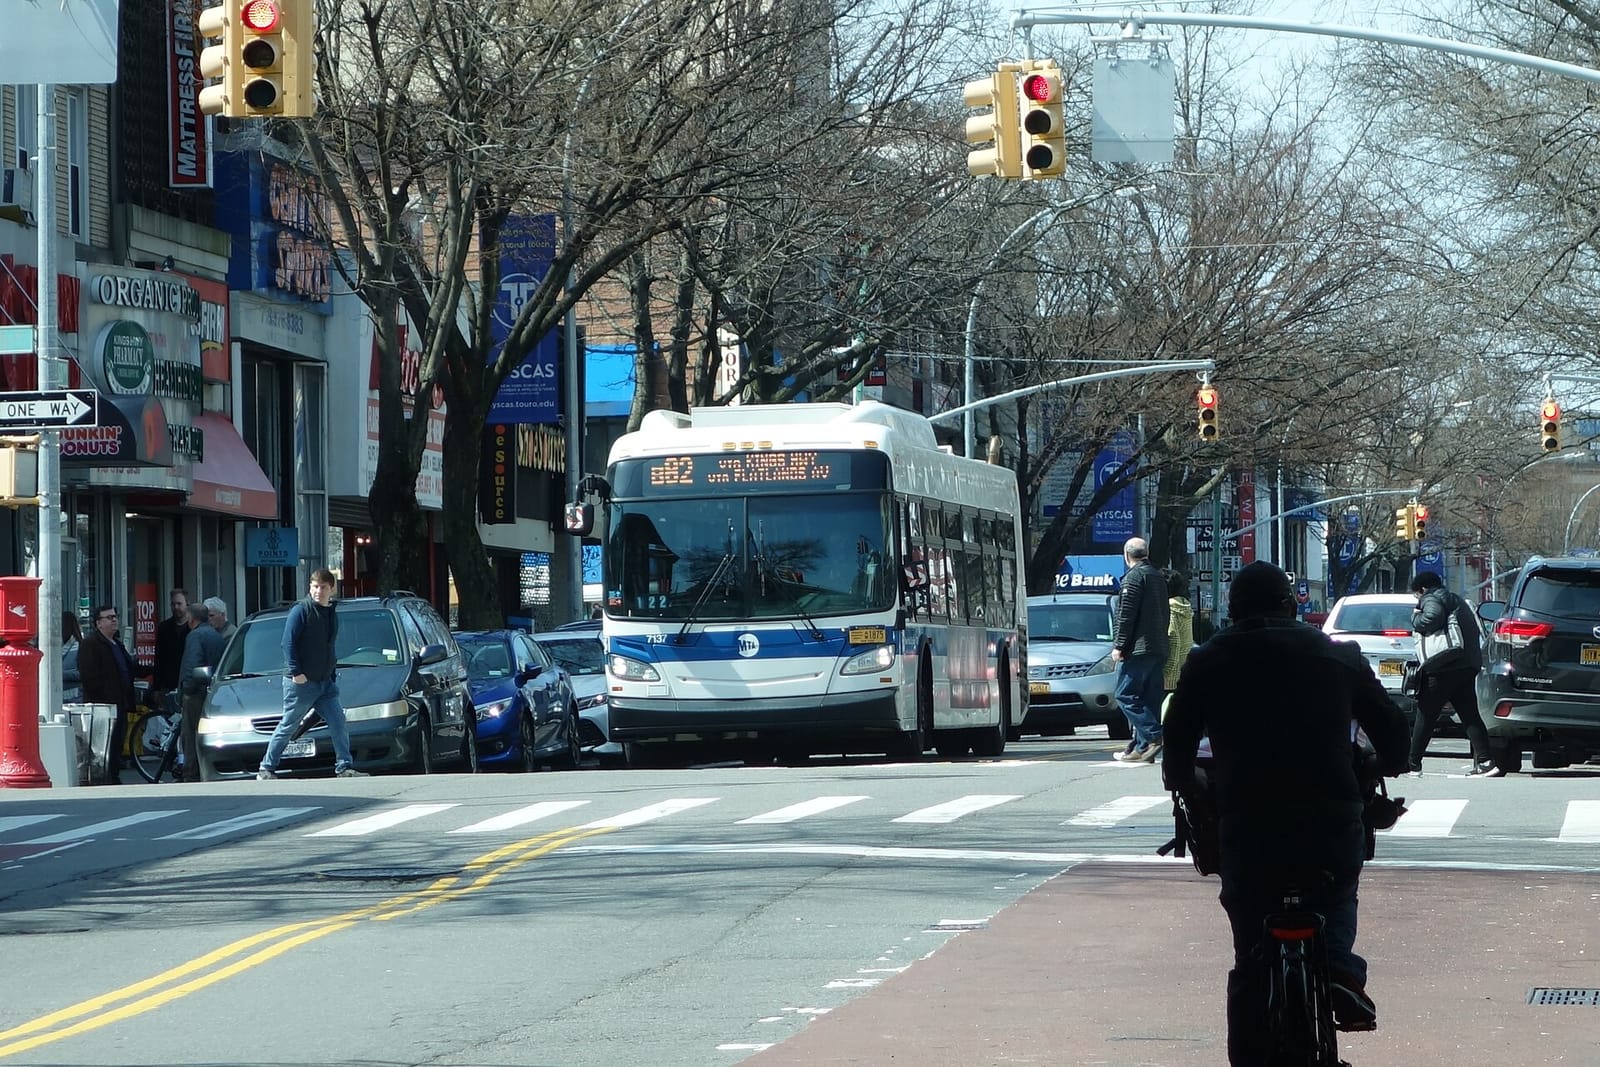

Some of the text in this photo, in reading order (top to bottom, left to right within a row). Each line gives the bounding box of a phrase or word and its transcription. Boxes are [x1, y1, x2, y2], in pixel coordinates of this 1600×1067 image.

[100, 275, 179, 313] ORGANIC
[113, 346, 144, 366] PHARMACY
[510, 363, 555, 379] SCAS
[7, 402, 80, 417] ONE WAY
[492, 399, 555, 409] yscas.touro.edu
[1071, 573, 1114, 587] Bank
[136, 601, 154, 619] TOP
[136, 621, 154, 632] RATED
[646, 634, 668, 644] 7137
[738, 639, 757, 652] MTA
